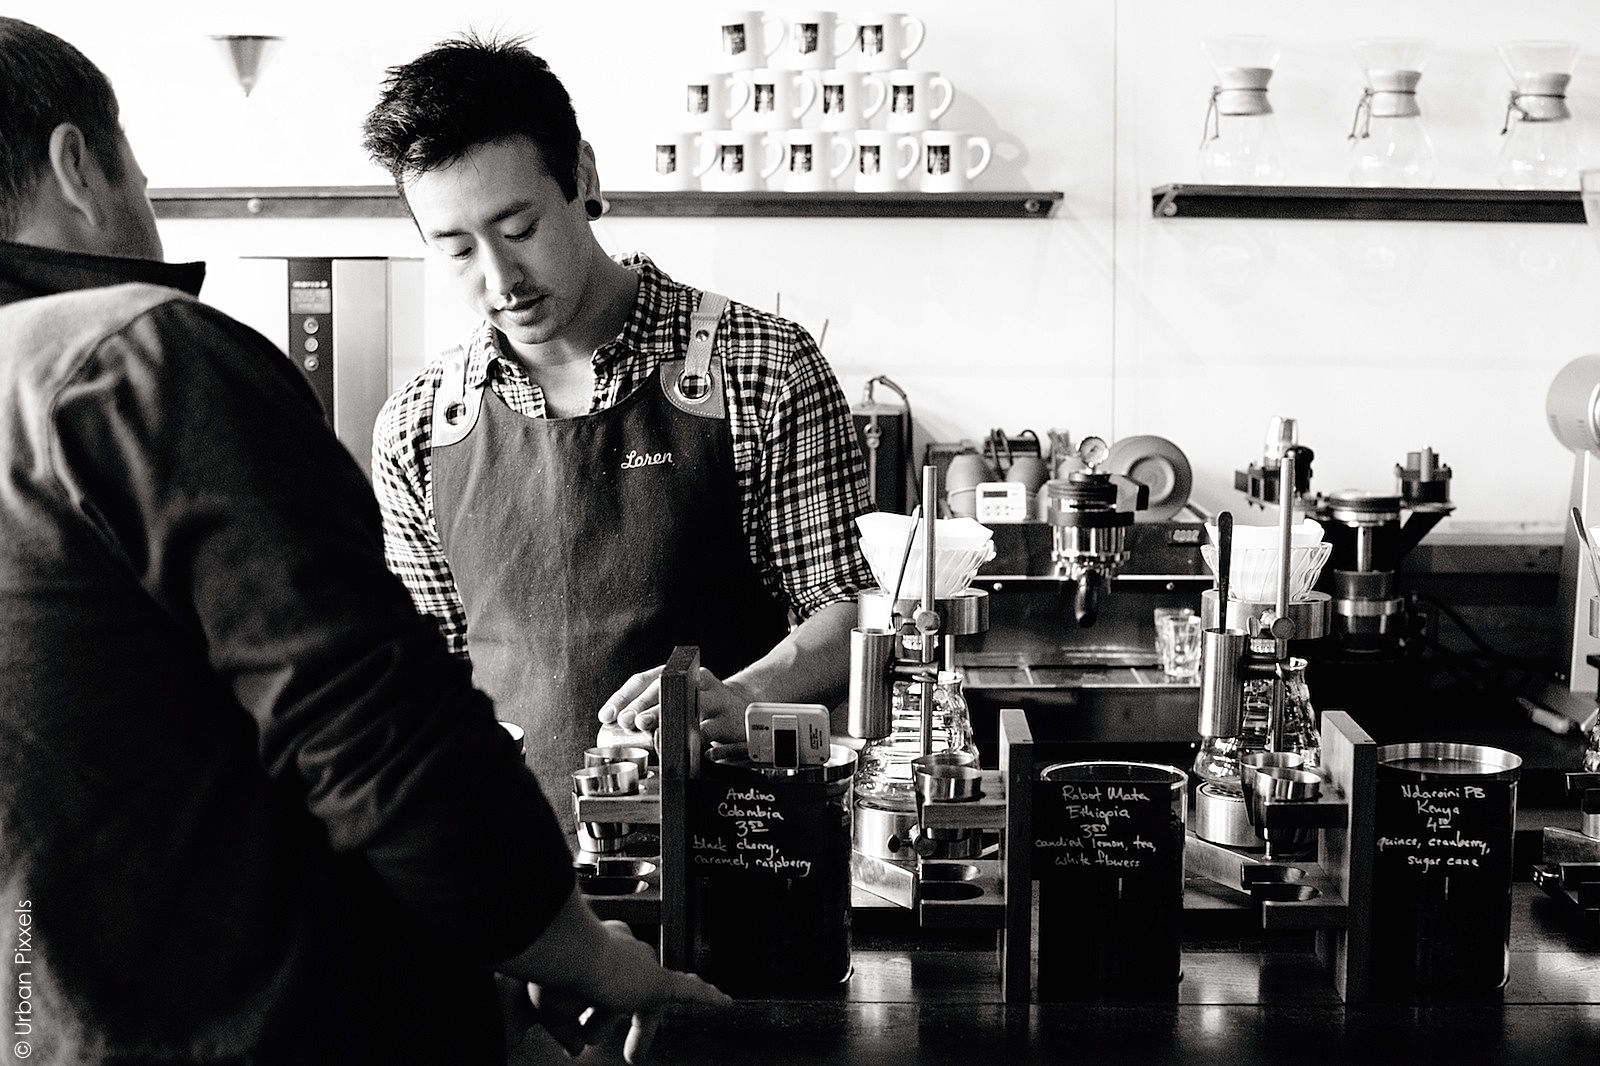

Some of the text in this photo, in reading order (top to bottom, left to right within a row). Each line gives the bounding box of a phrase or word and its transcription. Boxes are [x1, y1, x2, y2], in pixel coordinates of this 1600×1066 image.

[620, 449, 673, 470] Loren
[1062, 784, 1102, 802] Robot
[717, 801, 785, 821] Colombia
[1065, 804, 1131, 826] Ethiopia
[1416, 799, 1460, 822] Kenya
[1034, 836, 1085, 849] candied
[1092, 837, 1129, 852] lemon,
[1376, 836, 1422, 852] quince,
[694, 853, 812, 878] caramel, raspberry
[1054, 849, 1141, 868] white flowers
[1407, 855, 1441, 874] sugar
